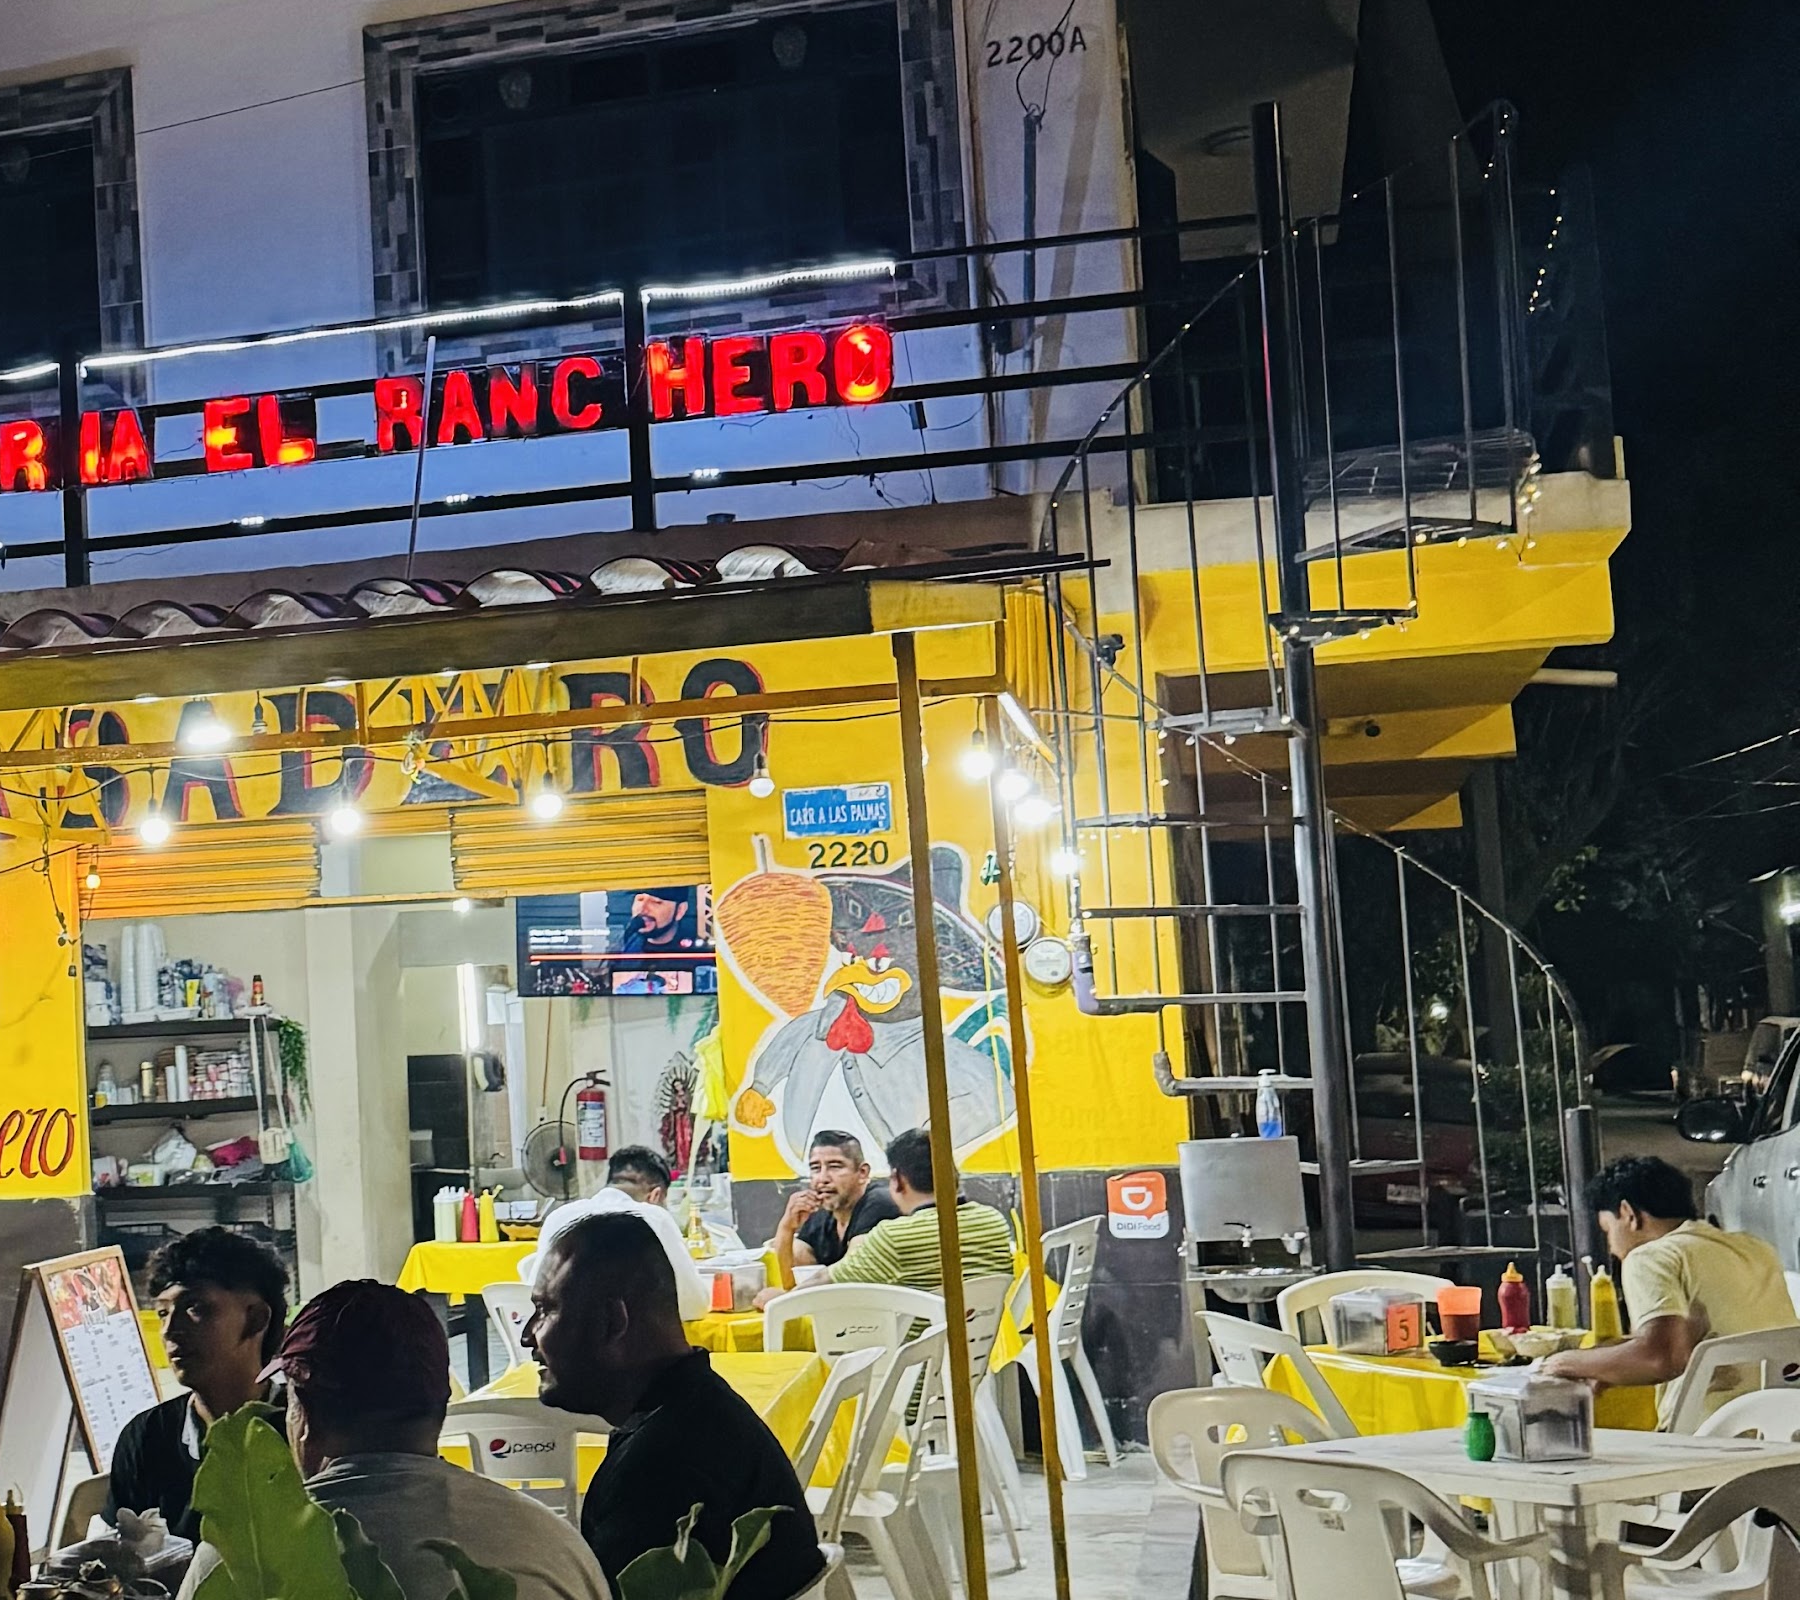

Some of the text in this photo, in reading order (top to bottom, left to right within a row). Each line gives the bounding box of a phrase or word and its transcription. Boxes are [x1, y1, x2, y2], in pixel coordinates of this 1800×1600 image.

[986, 25, 1088, 68] 2200A
[203, 394, 317, 474] EL
[374, 322, 895, 455] RANCHERO
[818, 807, 828, 824] A
[828, 804, 848, 824] LAS
[850, 801, 888, 823] PALMAS
[808, 839, 890, 870] 2220
